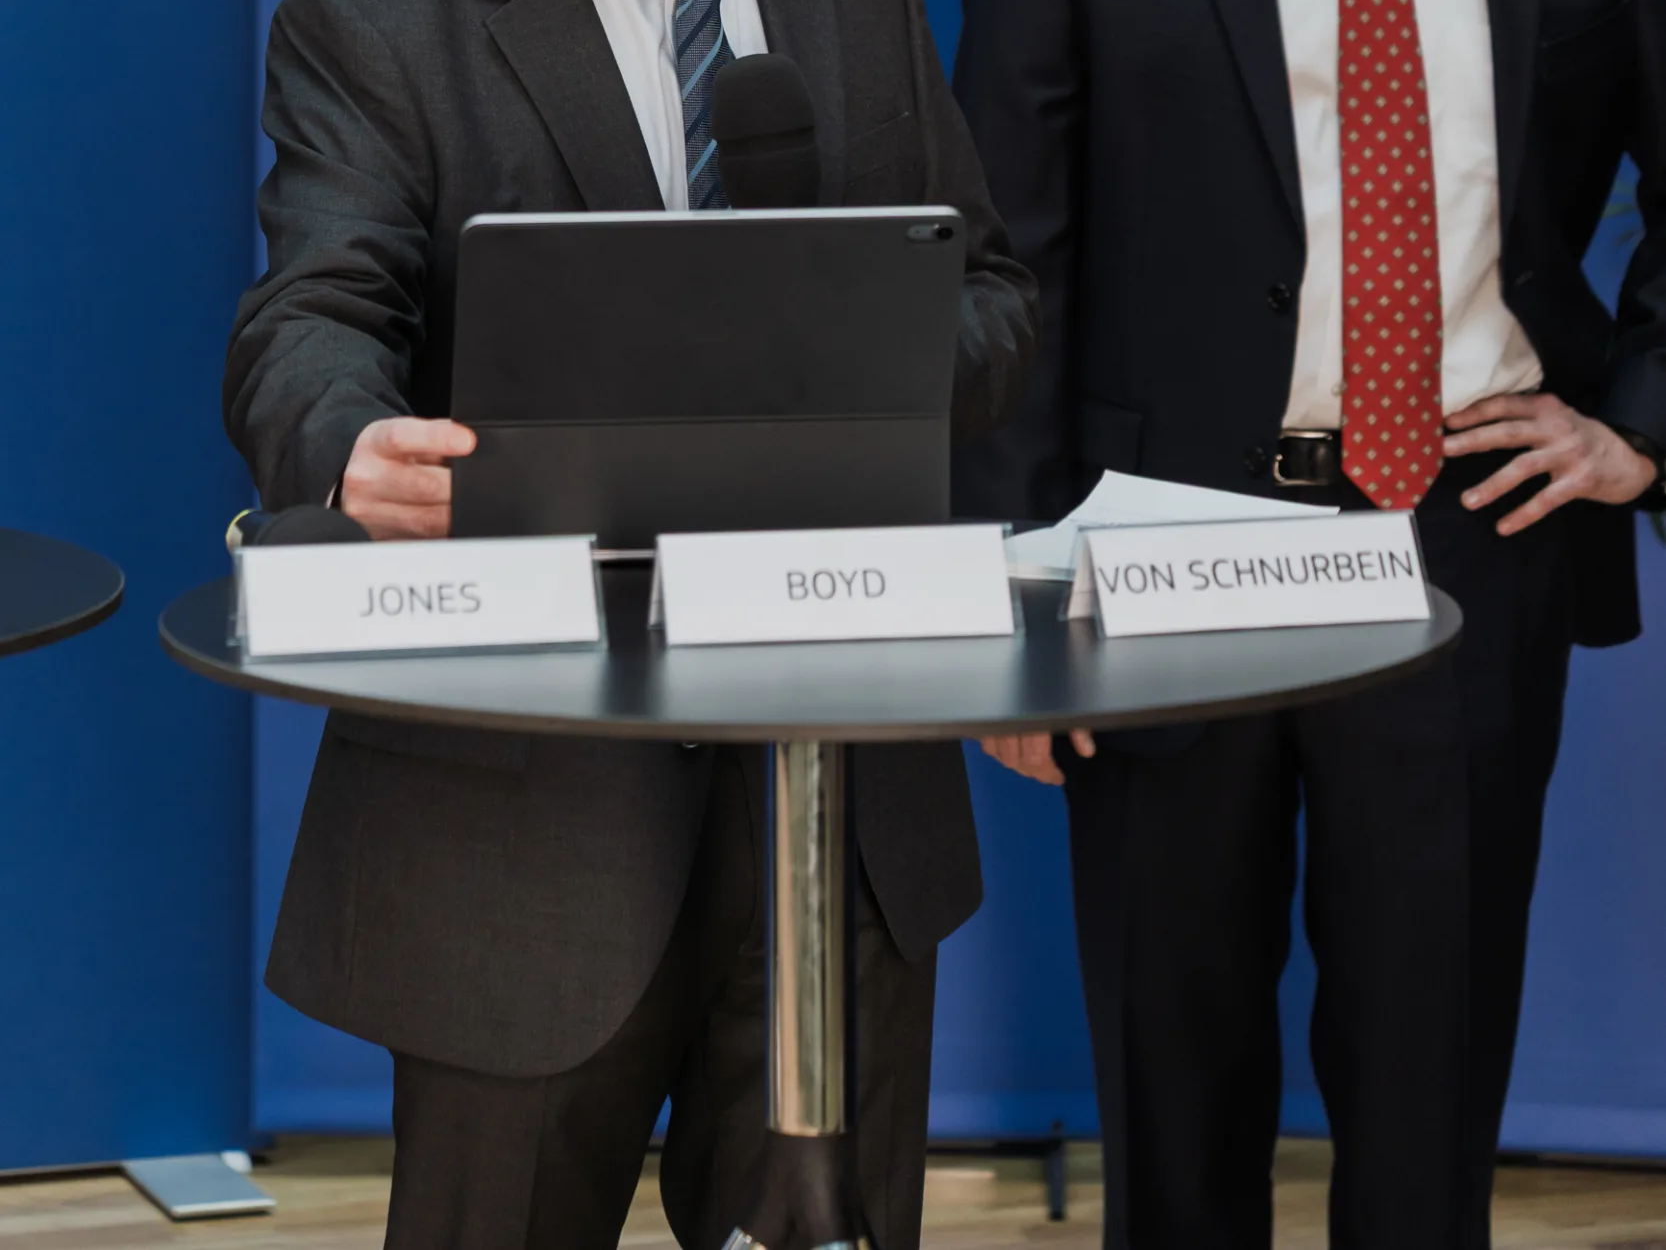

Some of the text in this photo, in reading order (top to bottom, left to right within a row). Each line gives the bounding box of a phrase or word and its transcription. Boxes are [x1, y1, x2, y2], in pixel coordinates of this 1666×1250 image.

[786, 568, 887, 601] BOYD
[1100, 548, 1415, 596] VON SCHNURBEIN
[361, 582, 482, 617] JONES
